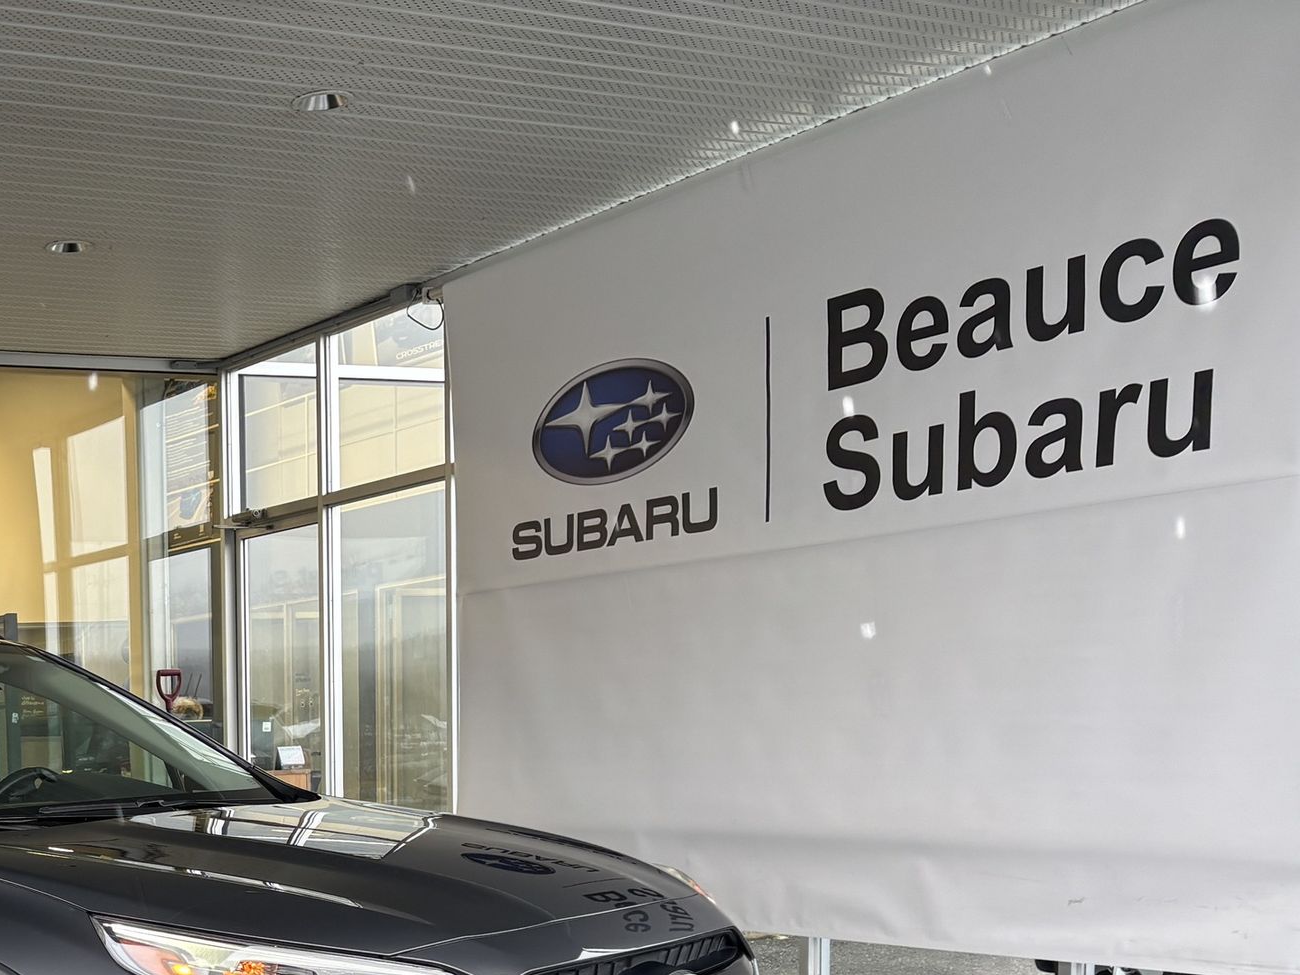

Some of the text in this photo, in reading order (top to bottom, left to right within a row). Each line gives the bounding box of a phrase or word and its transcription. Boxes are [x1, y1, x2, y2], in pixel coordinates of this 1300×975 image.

[395, 340, 442, 360] CROSSTRE
[826, 217, 1241, 392] Beauce
[823, 368, 1214, 512] Subaru
[512, 487, 718, 561] SUBARU
